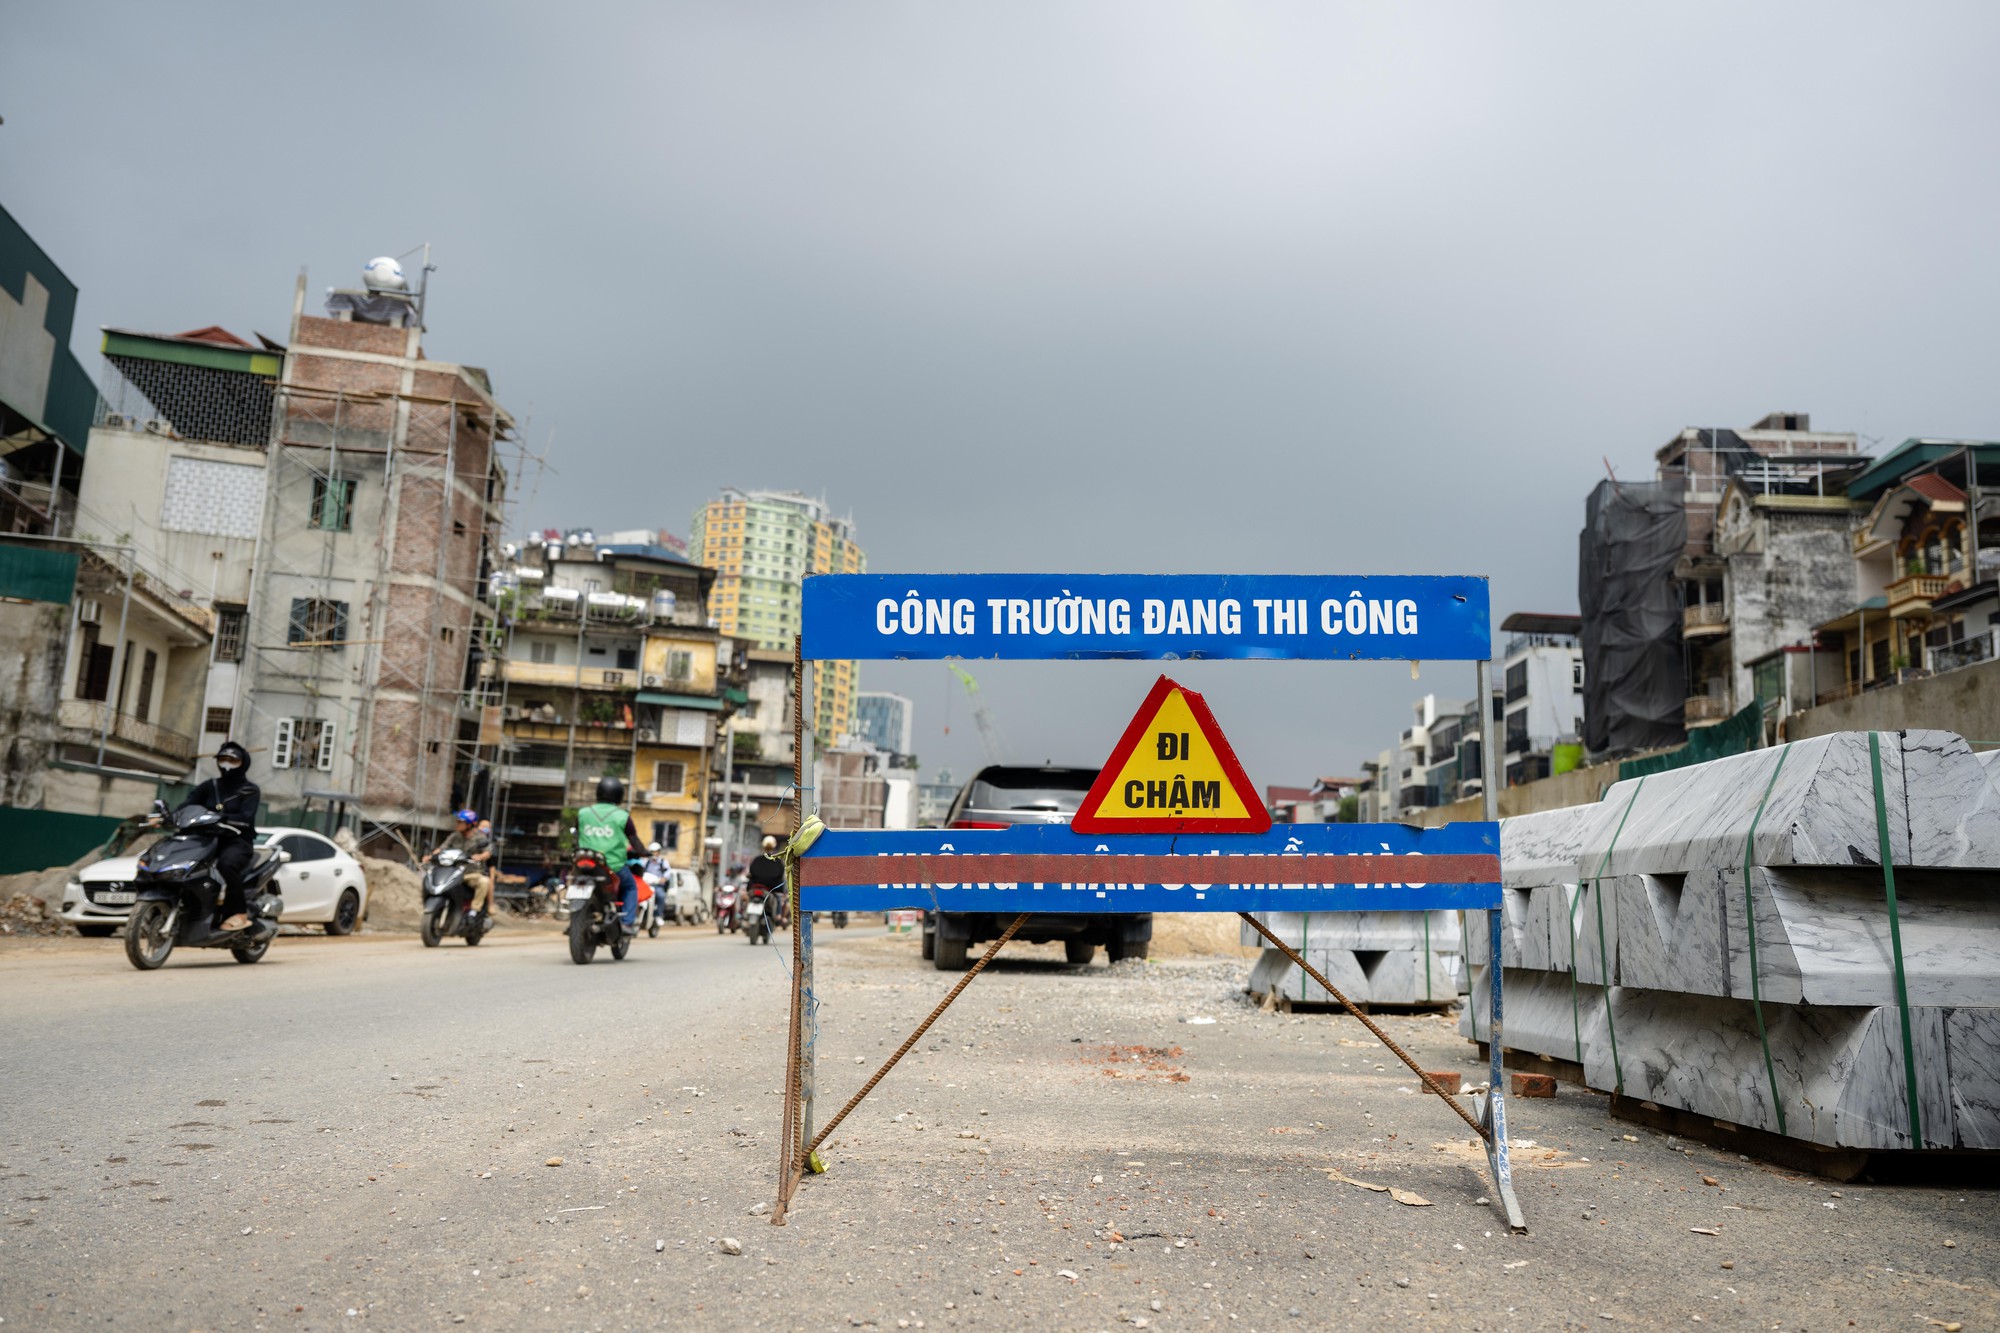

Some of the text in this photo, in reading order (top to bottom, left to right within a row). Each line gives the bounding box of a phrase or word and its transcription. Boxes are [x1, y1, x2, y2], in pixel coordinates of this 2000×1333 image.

[876, 589, 1418, 635] CÔNG TRƯỜNG ĐANG THI CÔNG
[1156, 732, 1189, 761] ĐI
[1124, 774, 1221, 815] CHẬM
[584, 824, 614, 838] Grab
